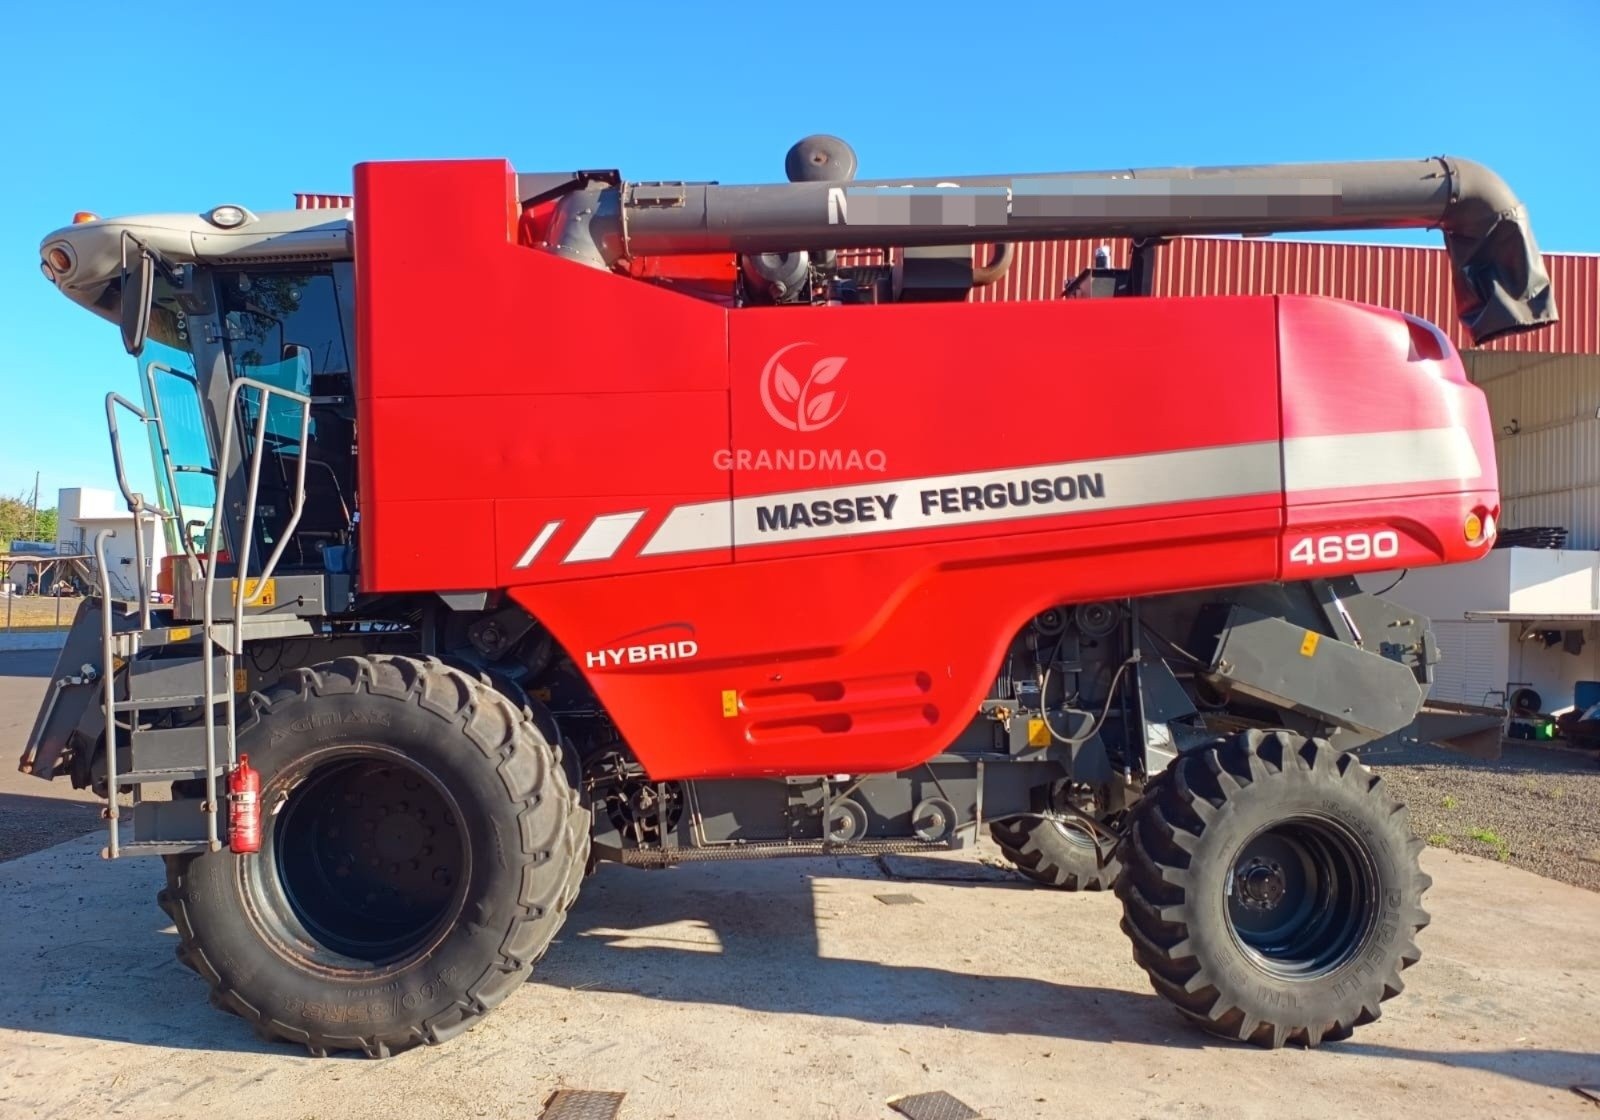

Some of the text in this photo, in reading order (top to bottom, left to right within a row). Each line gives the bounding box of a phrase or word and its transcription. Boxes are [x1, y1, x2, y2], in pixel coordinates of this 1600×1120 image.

[756, 473, 1105, 532] MASSEY FERGUSON
[1289, 531, 1399, 566] 4690
[585, 640, 698, 668] HYBRID
[1332, 887, 1402, 1001] PIRELLI
